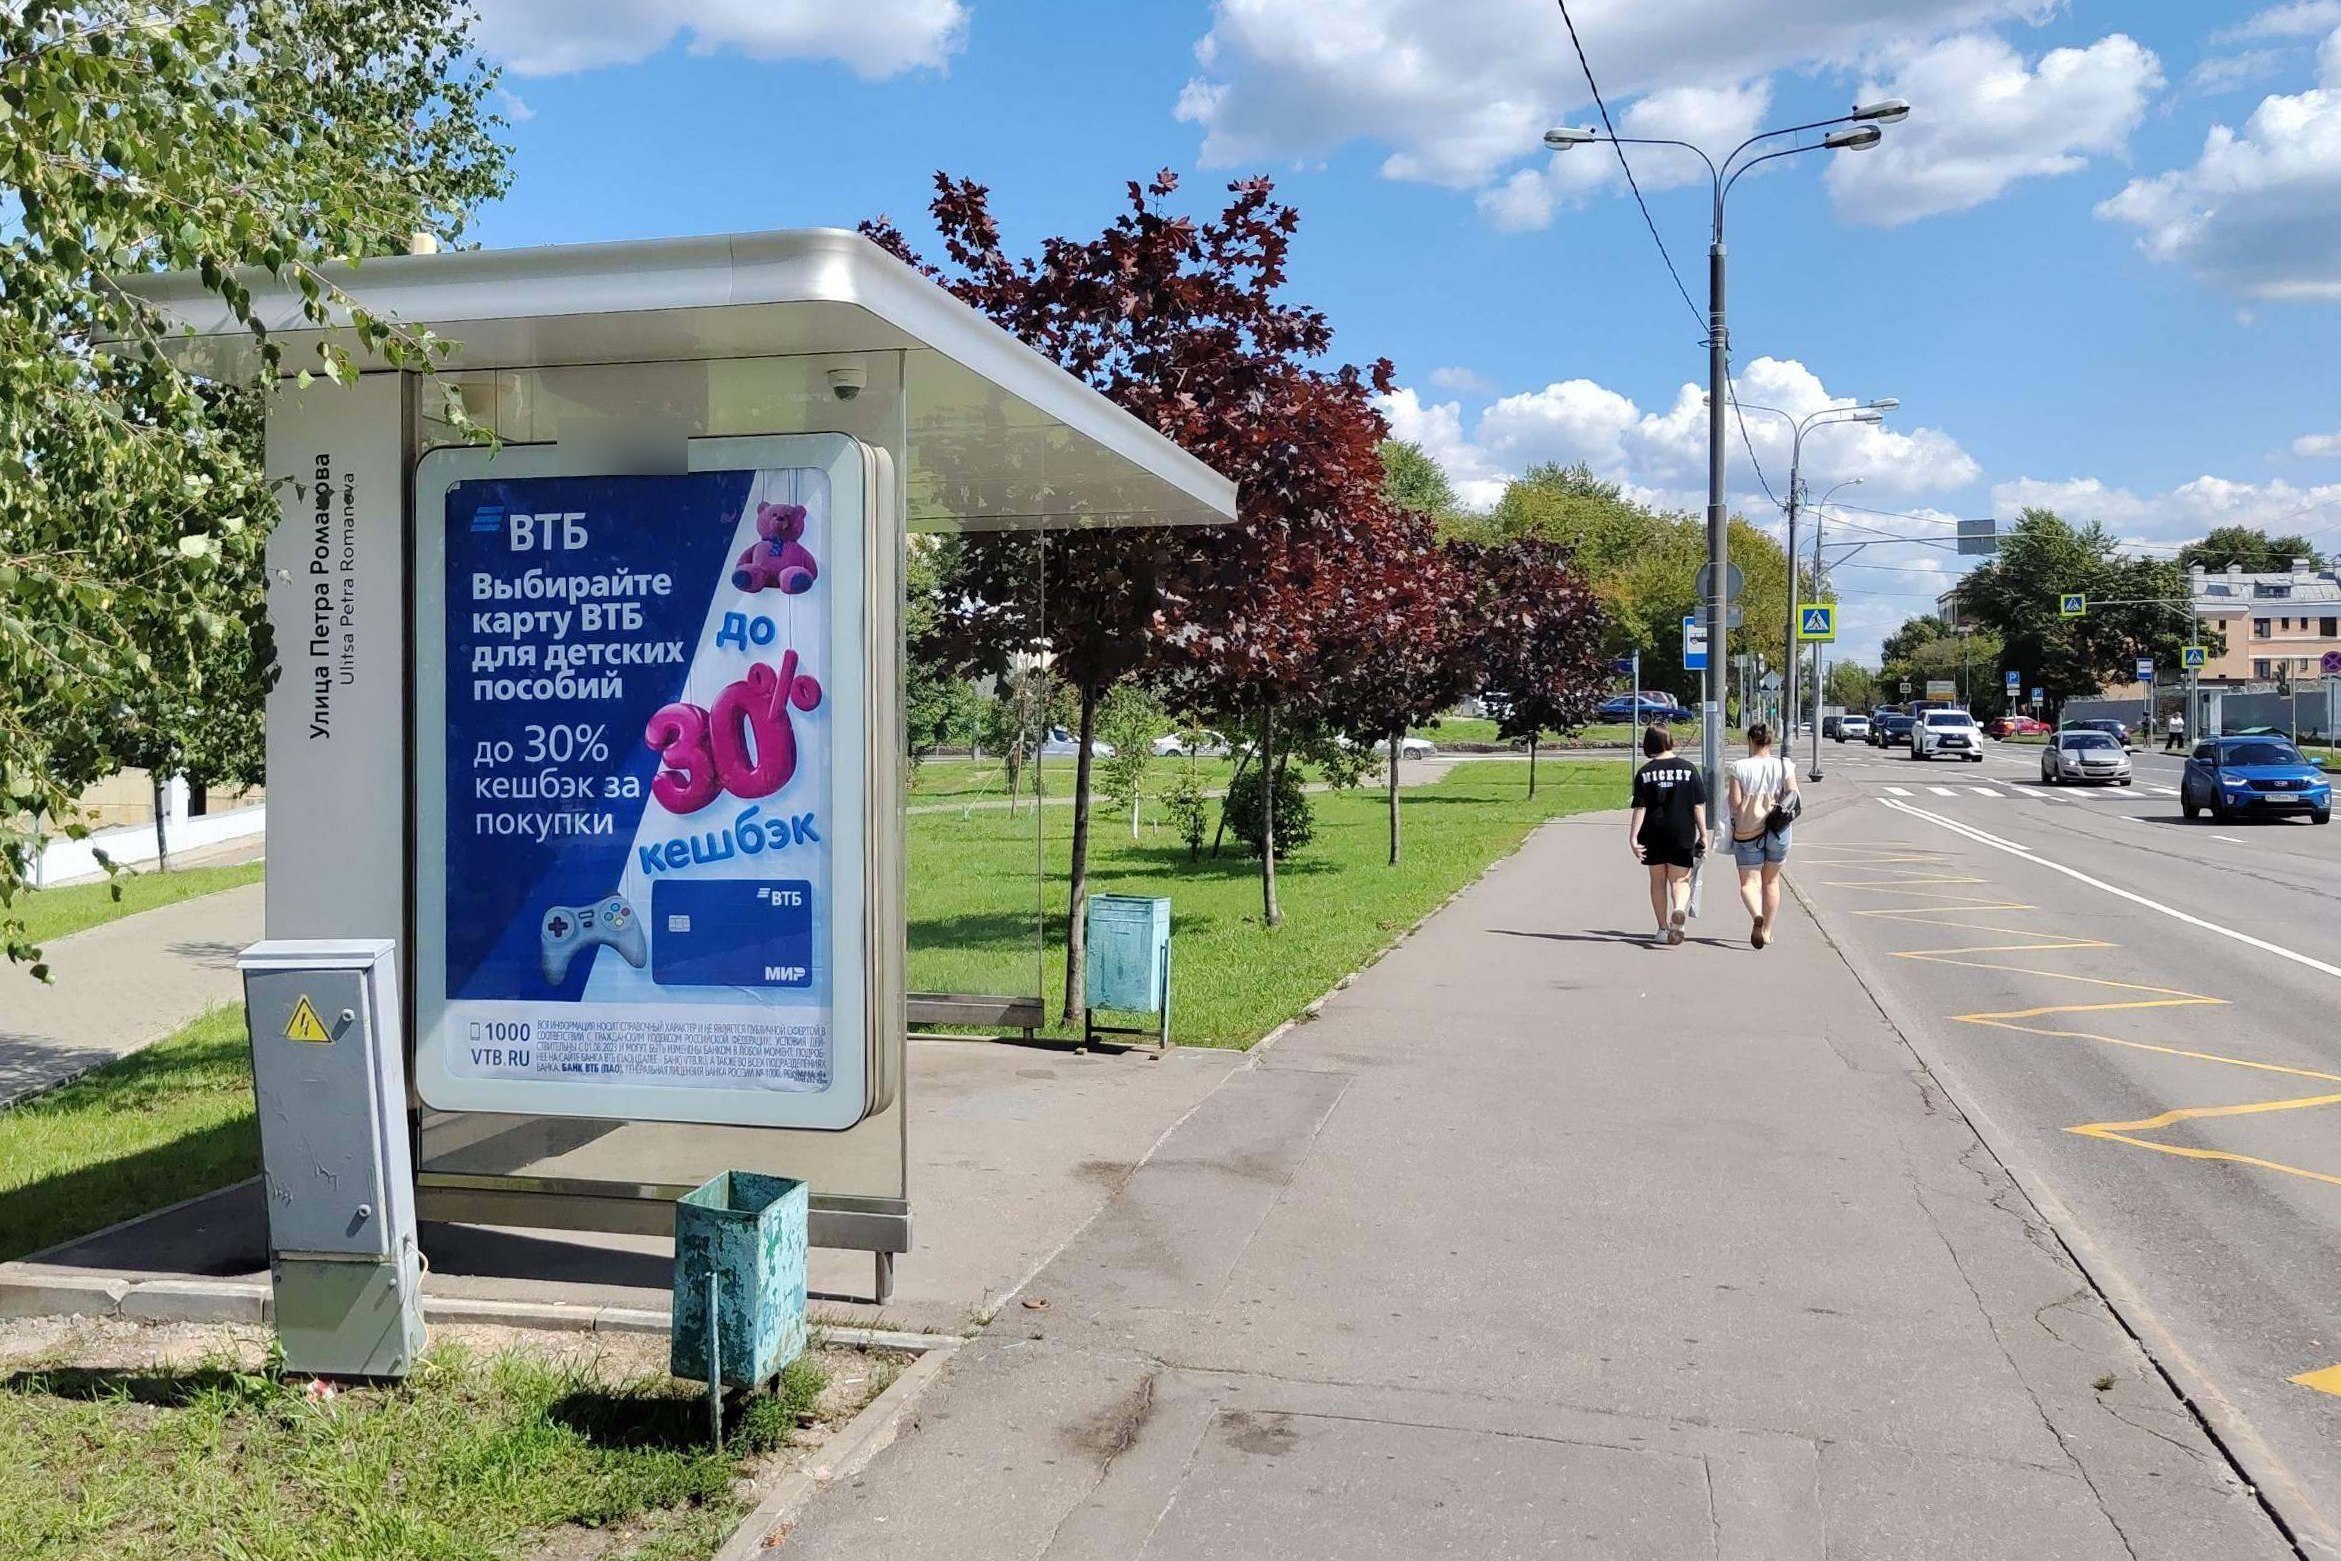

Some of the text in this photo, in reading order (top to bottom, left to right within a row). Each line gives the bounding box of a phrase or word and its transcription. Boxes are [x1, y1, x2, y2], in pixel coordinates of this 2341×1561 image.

[509, 512, 588, 551] ВТБ
[310, 453, 334, 740] Улица Петра Ромаова
[340, 579, 355, 627] Petra
[472, 568, 672, 605] Выбирайте
[472, 602, 643, 640] карту ВТБ
[716, 611, 776, 652] до
[339, 634, 355, 685] Ulitsa
[472, 640, 684, 672] для детских
[473, 670, 623, 701] пособий
[473, 724, 609, 768] до 30%
[645, 649, 823, 815] 30%
[475, 767, 640, 798] кешбэк за
[1641, 769, 1692, 784] MICKEY
[475, 811, 614, 843] покупки
[638, 804, 821, 875] кешбэк
[771, 891, 802, 906] ВТБ
[764, 966, 806, 982] МИР
[485, 1022, 530, 1041] 1000
[471, 1049, 530, 1067] VTB.RU
[561, 1064, 584, 1073] БАНК
[585, 1064, 599, 1073] ВТБ
